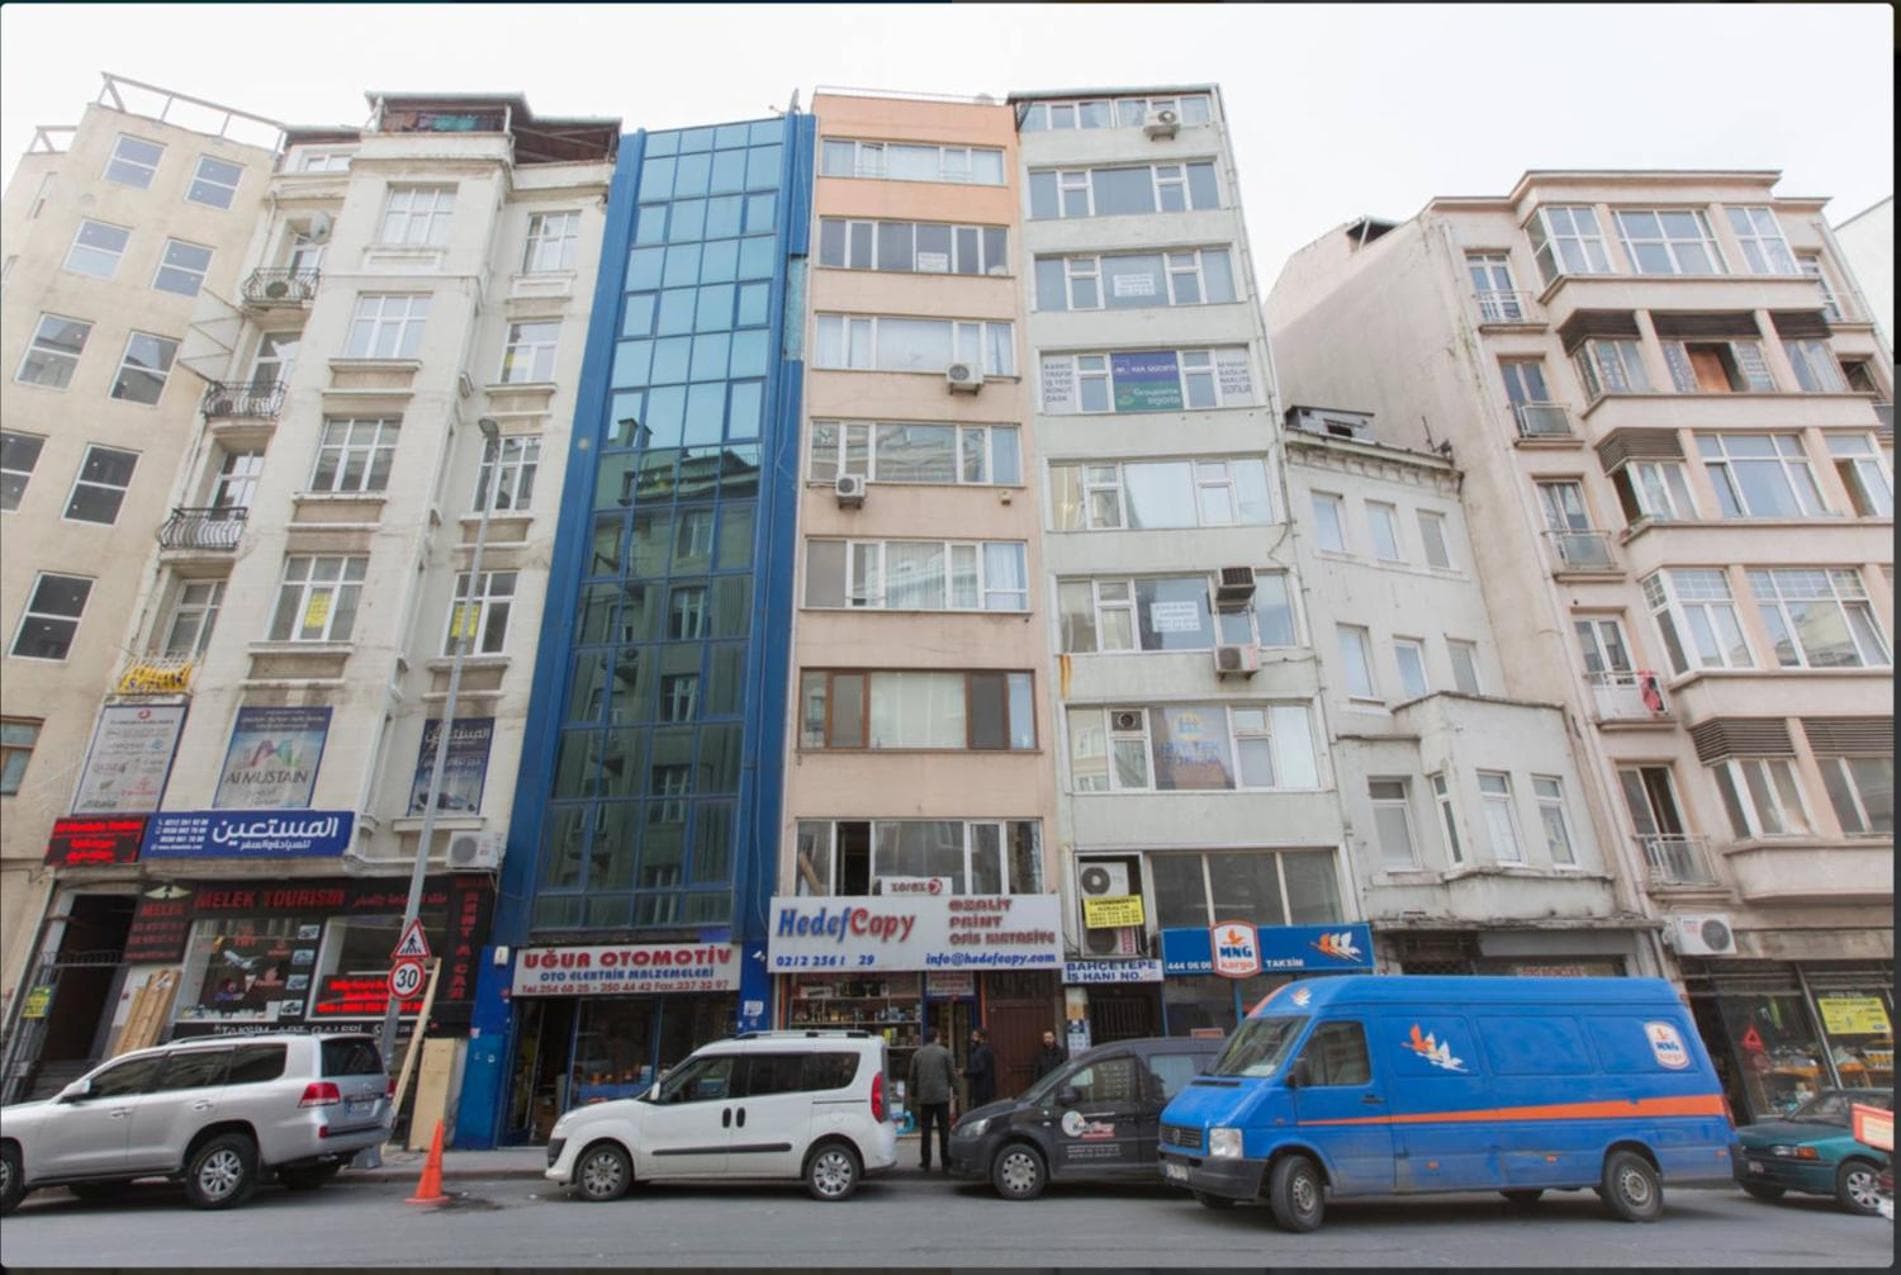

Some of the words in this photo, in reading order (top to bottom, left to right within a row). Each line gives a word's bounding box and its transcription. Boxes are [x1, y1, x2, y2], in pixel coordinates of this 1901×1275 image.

[212, 816, 340, 847] المستعين
[194, 890, 256, 909] MELEK
[263, 888, 345, 908] TOURISM
[777, 906, 917, 943] HedefCopy
[524, 946, 591, 969] UĞUR
[600, 944, 733, 967] OTOMOTİV
[926, 951, 1057, 967] info@hedefcopy.com
[1219, 945, 1253, 958] MNG
[776, 955, 808, 967] 0212
[1220, 961, 1255, 971] kargo
[1265, 957, 1304, 968] TAKSİM
[396, 968, 418, 989] 30
[540, 971, 566, 981] OTO
